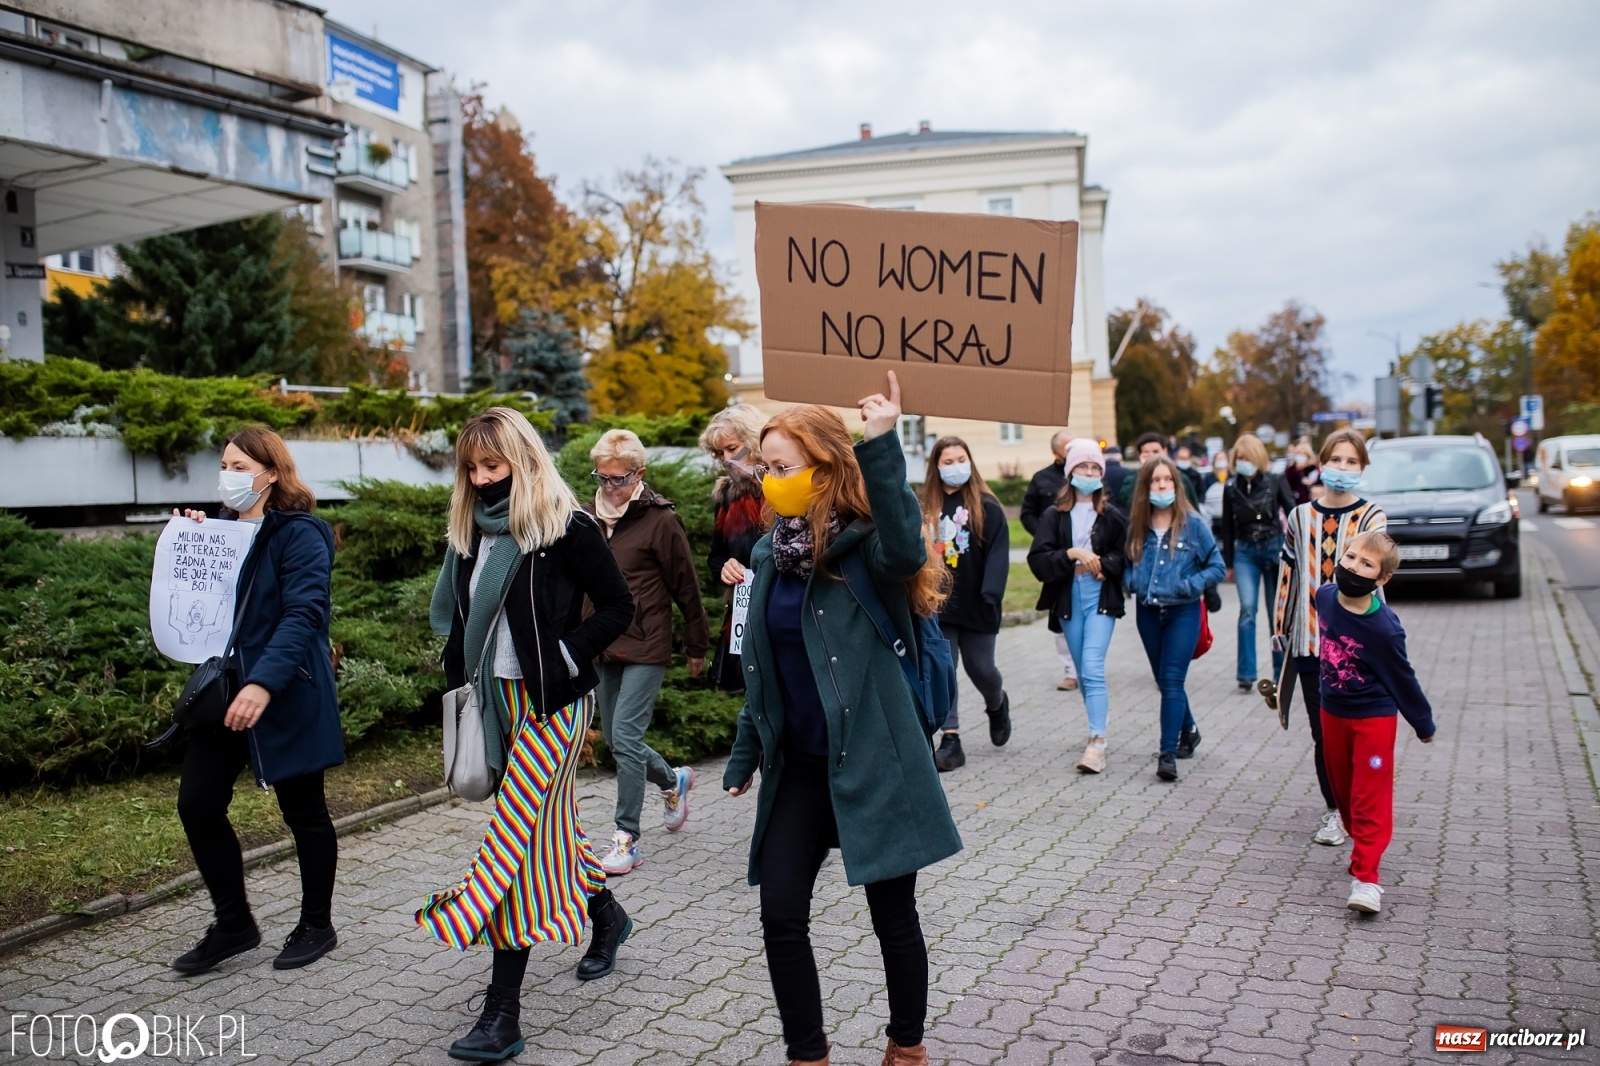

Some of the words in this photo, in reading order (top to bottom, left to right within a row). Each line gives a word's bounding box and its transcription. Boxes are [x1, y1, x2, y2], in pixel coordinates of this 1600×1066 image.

[787, 236, 850, 288] NO
[878, 242, 1046, 305] WOMEN
[821, 311, 885, 360] NO
[900, 316, 1012, 367] KRAJ
[177, 531, 205, 543] MILION
[209, 534, 226, 545] NAS
[172, 542, 188, 553] TAK
[191, 544, 220, 557] TERAZ
[210, 559, 217, 569] Z
[218, 561, 233, 571] NAS
[173, 567, 188, 581] SIĘ
[210, 571, 224, 583] NIE
